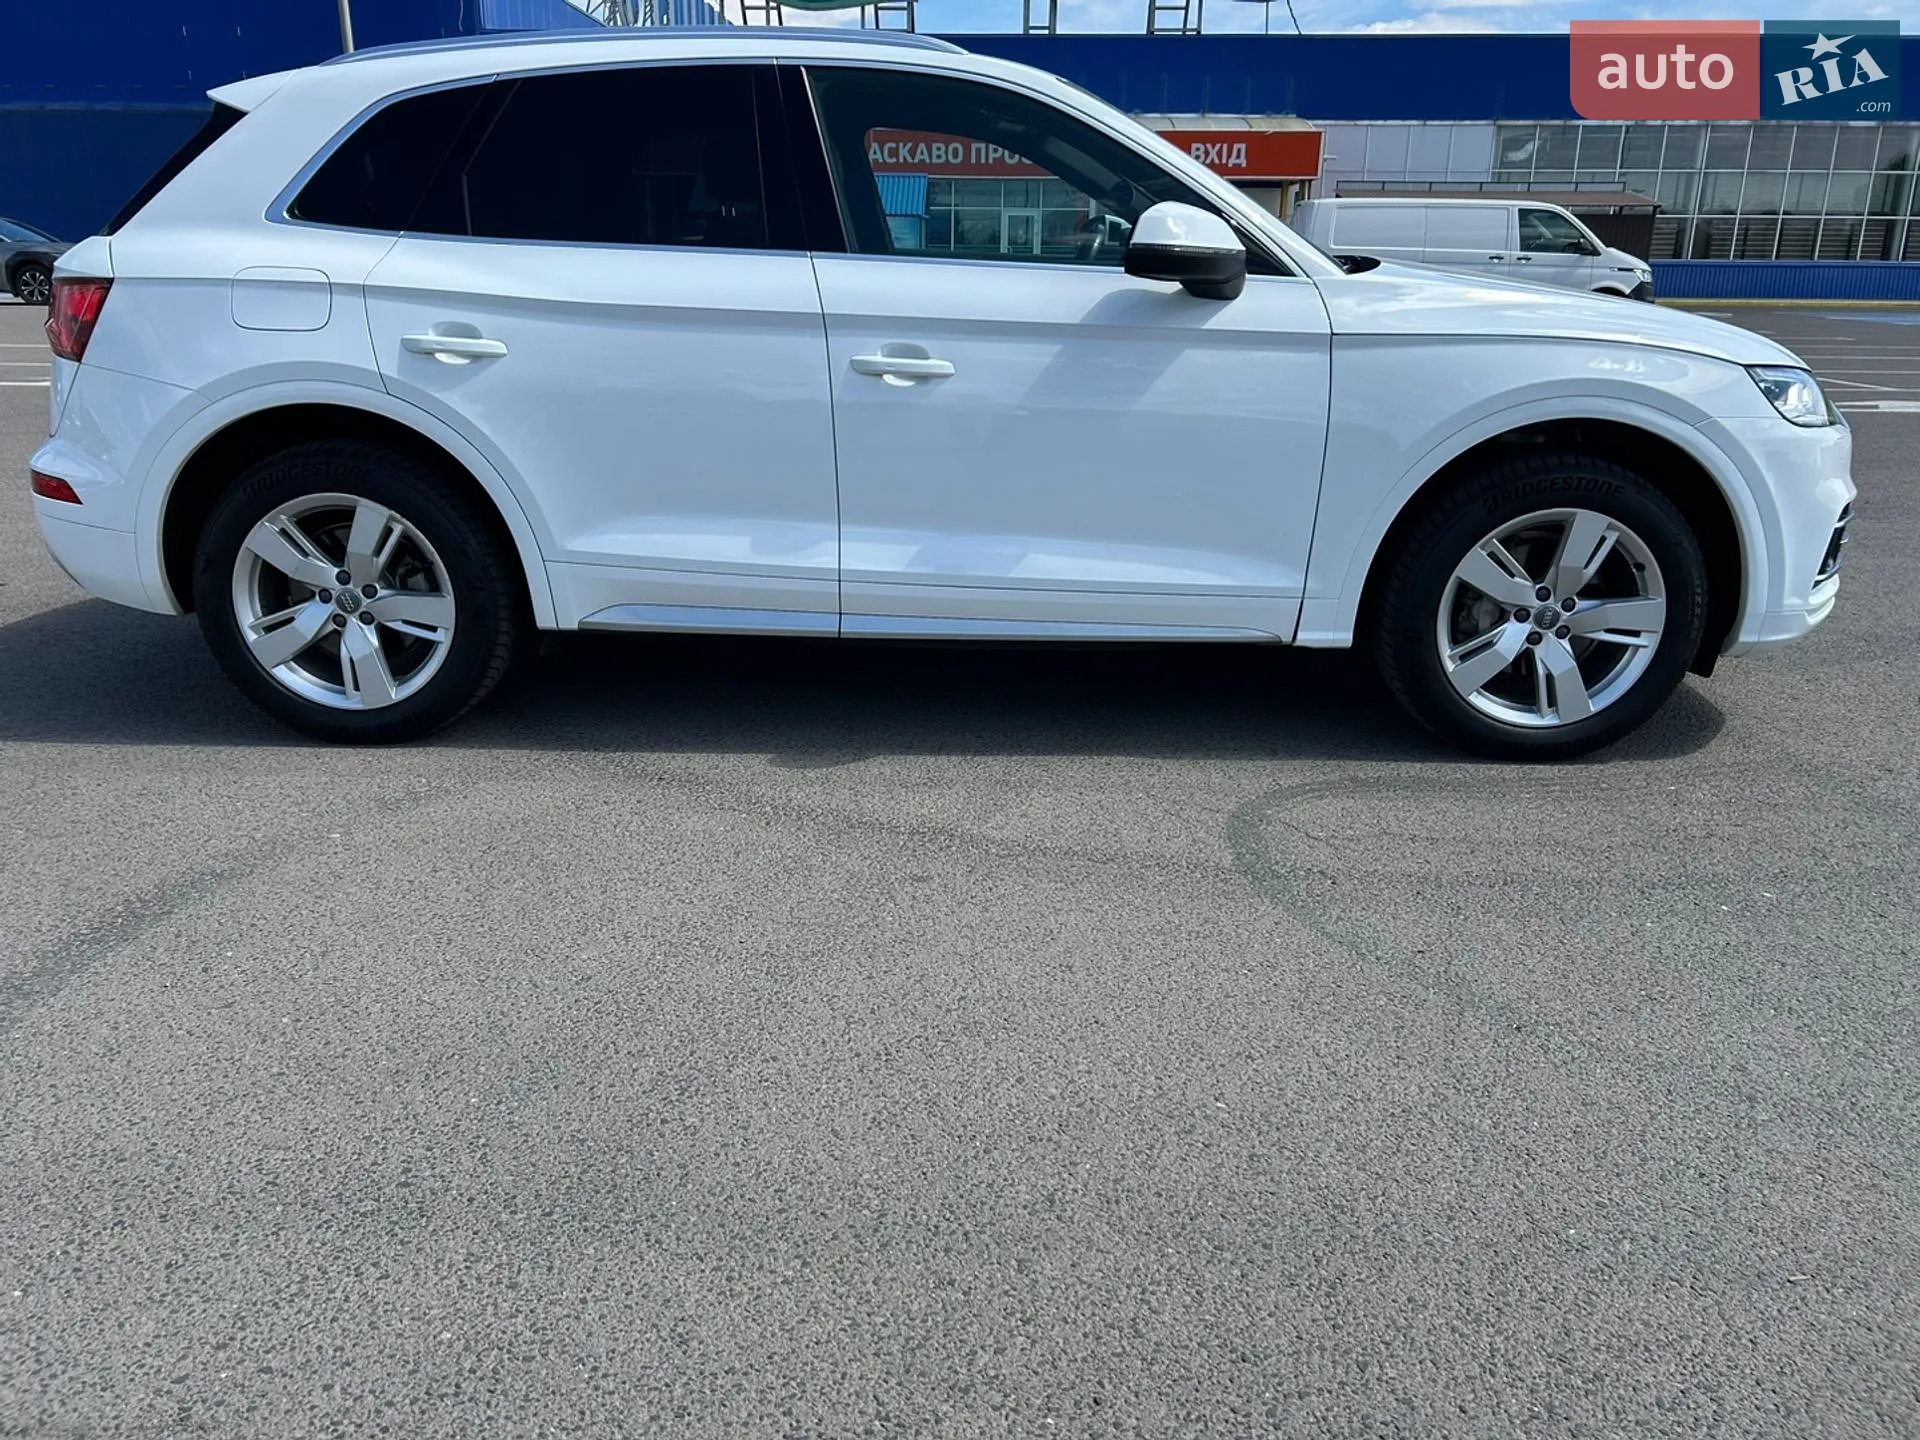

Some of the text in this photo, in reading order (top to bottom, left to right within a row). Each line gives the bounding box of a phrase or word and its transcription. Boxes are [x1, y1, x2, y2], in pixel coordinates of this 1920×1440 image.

[1190, 143, 1247, 168] ВХІД
[242, 464, 375, 502] BRIDGESTONE
[1483, 477, 1625, 513] BRIDGESTONE
